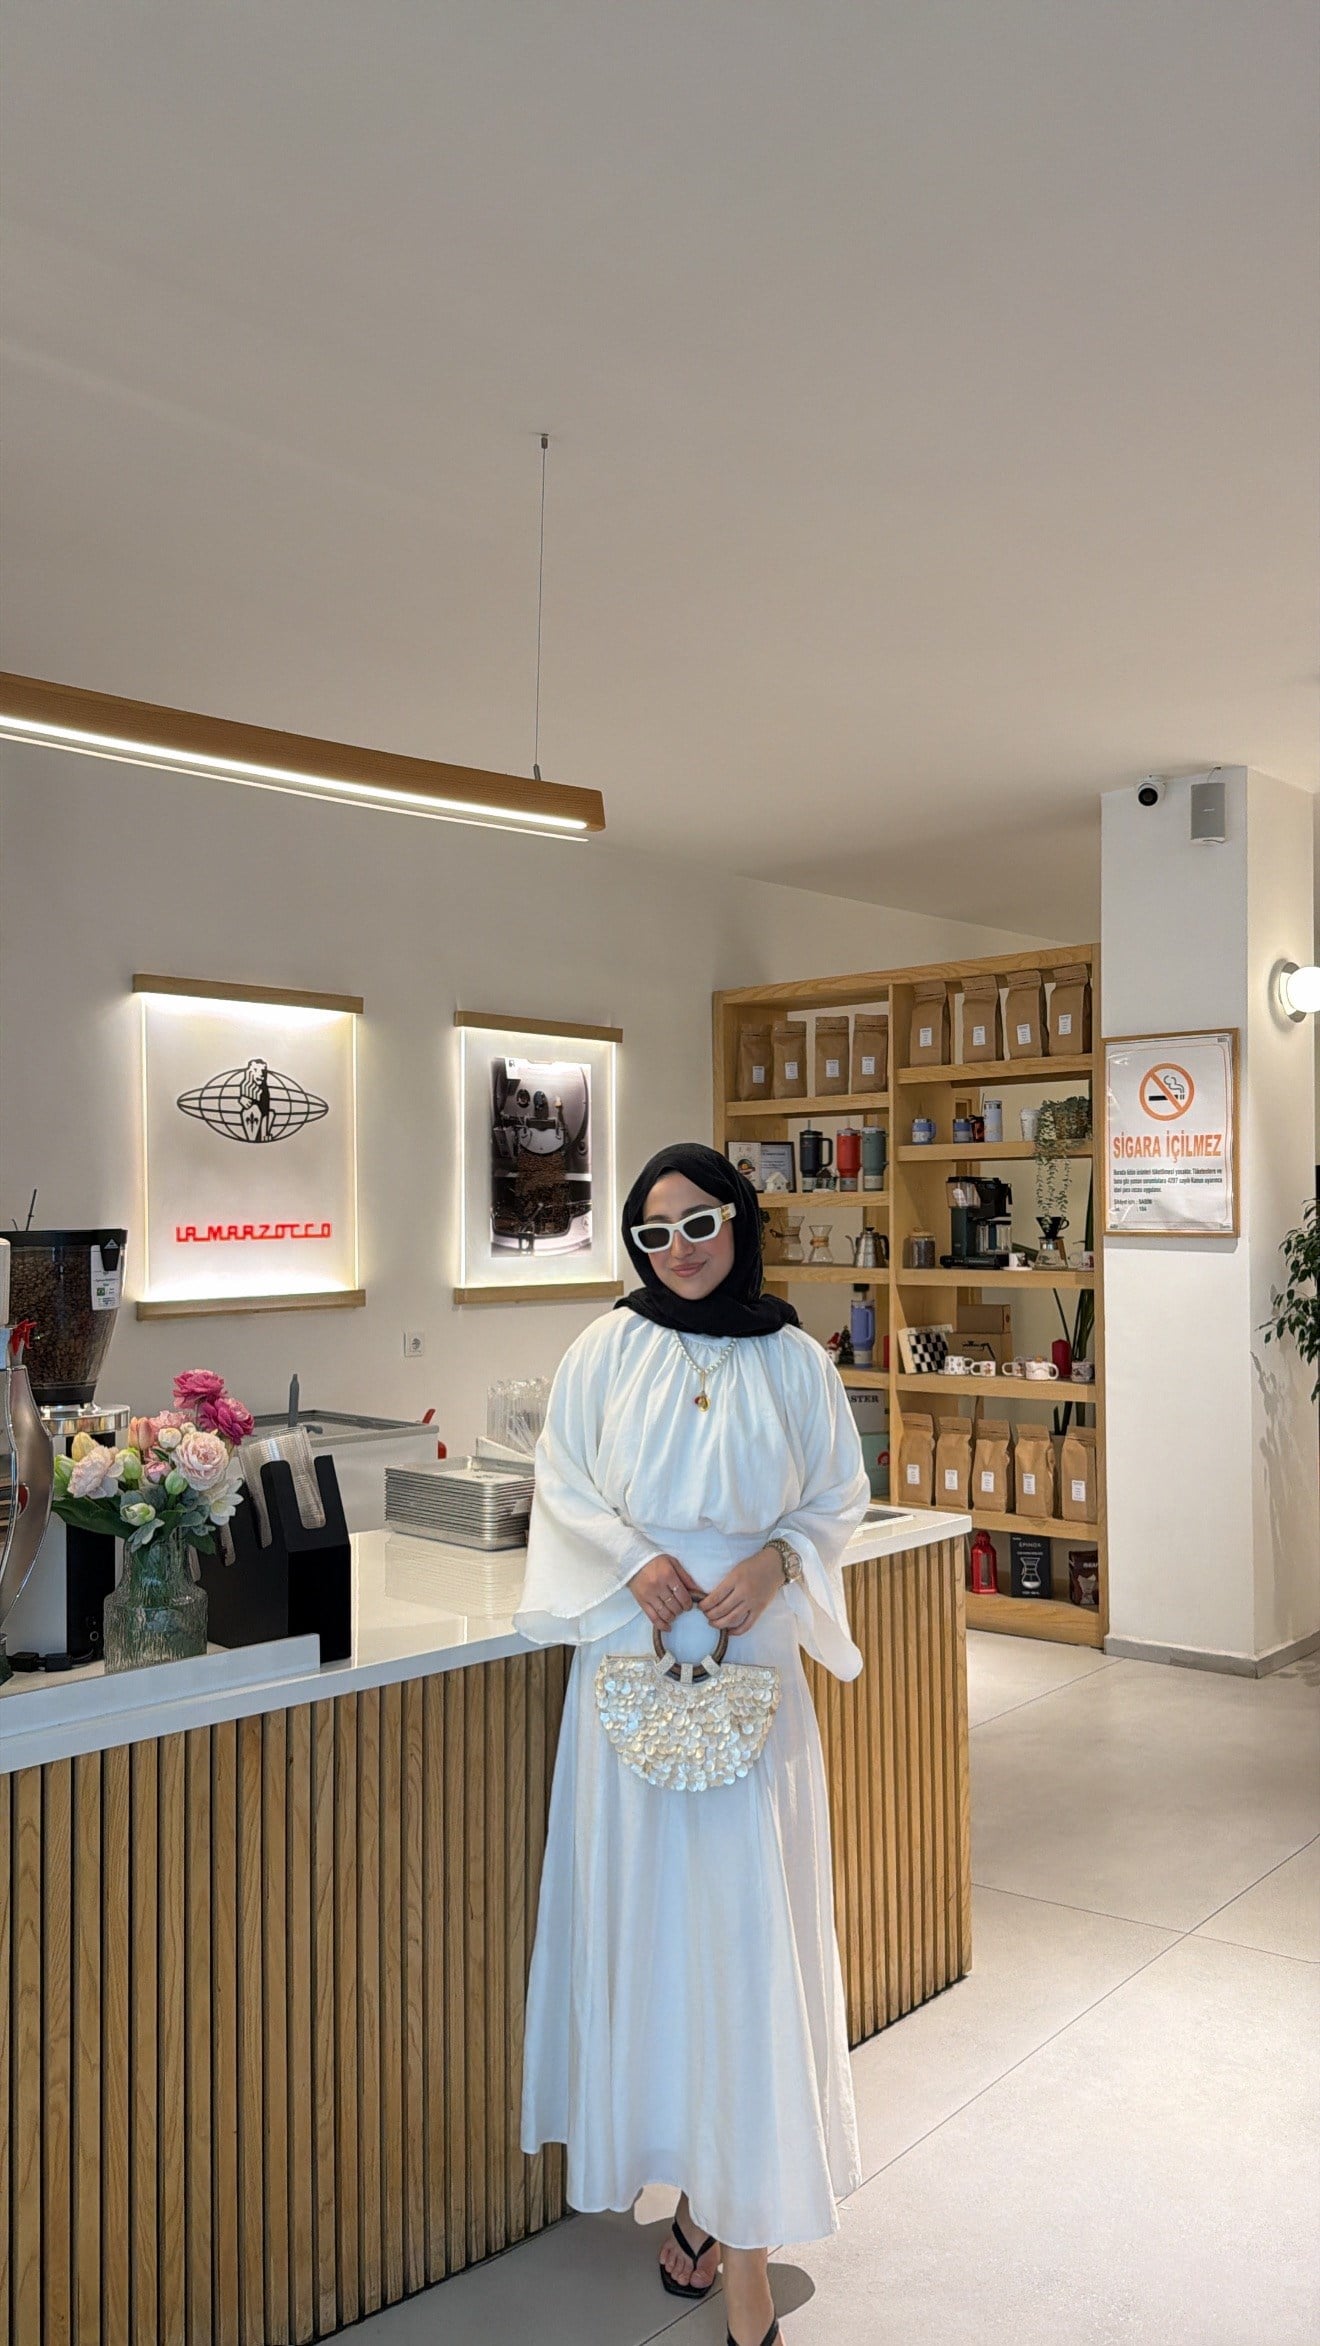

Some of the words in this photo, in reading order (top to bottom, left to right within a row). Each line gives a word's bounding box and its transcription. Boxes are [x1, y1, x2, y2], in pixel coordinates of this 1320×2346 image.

[1113, 1131, 1161, 1159] SİGARA
[1166, 1129, 1222, 1163] İÇİLMEZ
[176, 1226, 196, 1242] LA
[848, 1394, 879, 1403] STER
